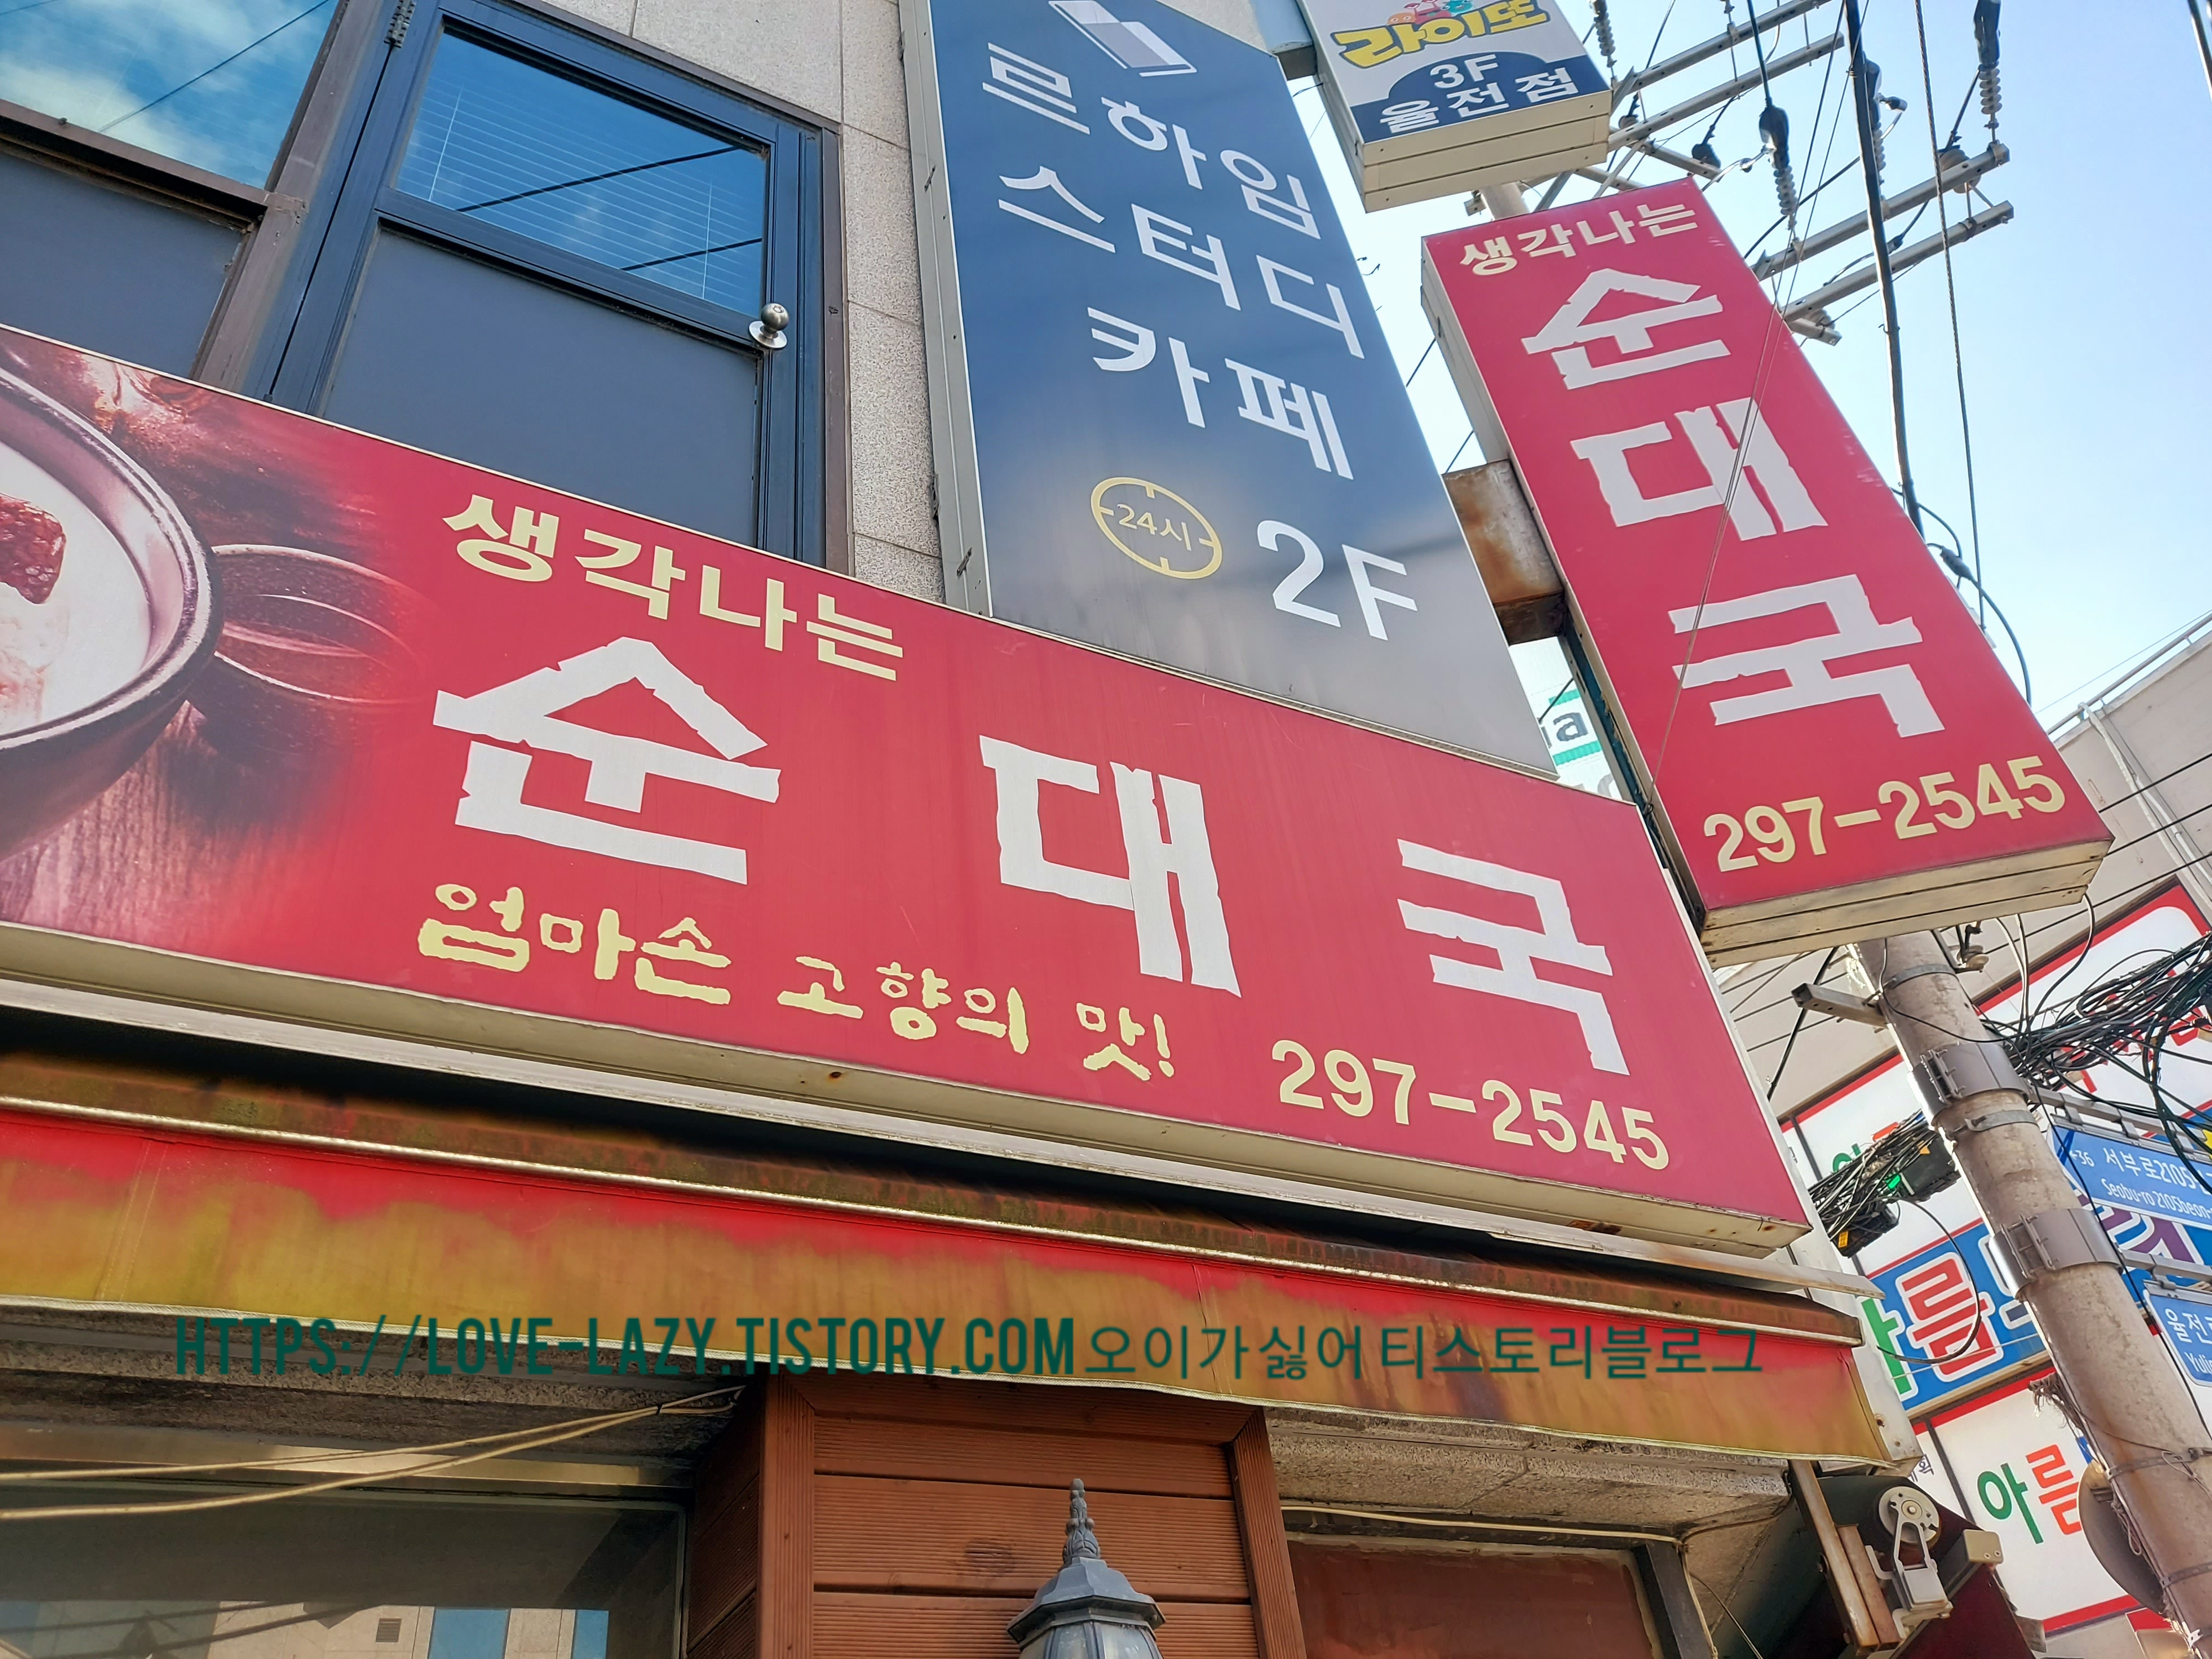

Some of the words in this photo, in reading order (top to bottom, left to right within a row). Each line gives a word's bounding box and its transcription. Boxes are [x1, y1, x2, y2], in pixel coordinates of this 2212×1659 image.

[1380, 67, 1579, 134] 율전점
[1430, 54, 1499, 88] 3F
[983, 42, 1321, 240] 르하임
[998, 165, 1364, 359] 스터디
[1460, 203, 1698, 276] 생각나는
[1087, 307, 1354, 480] 카페
[443, 494, 904, 681] 생각나는
[1117, 503, 1193, 551] 24시
[1257, 519, 1418, 641] 2F
[1703, 755, 2066, 873] 297-2545
[418, 884, 732, 1004] 엄마손
[777, 956, 1029, 1055] 고향의
[1076, 1003, 1175, 1082] 맛!
[1272, 1040, 1670, 1171] 297-2545
[2101, 1178, 2156, 1206] Seobu-ro
[2152, 1191, 2212, 1219] 2105beon-
